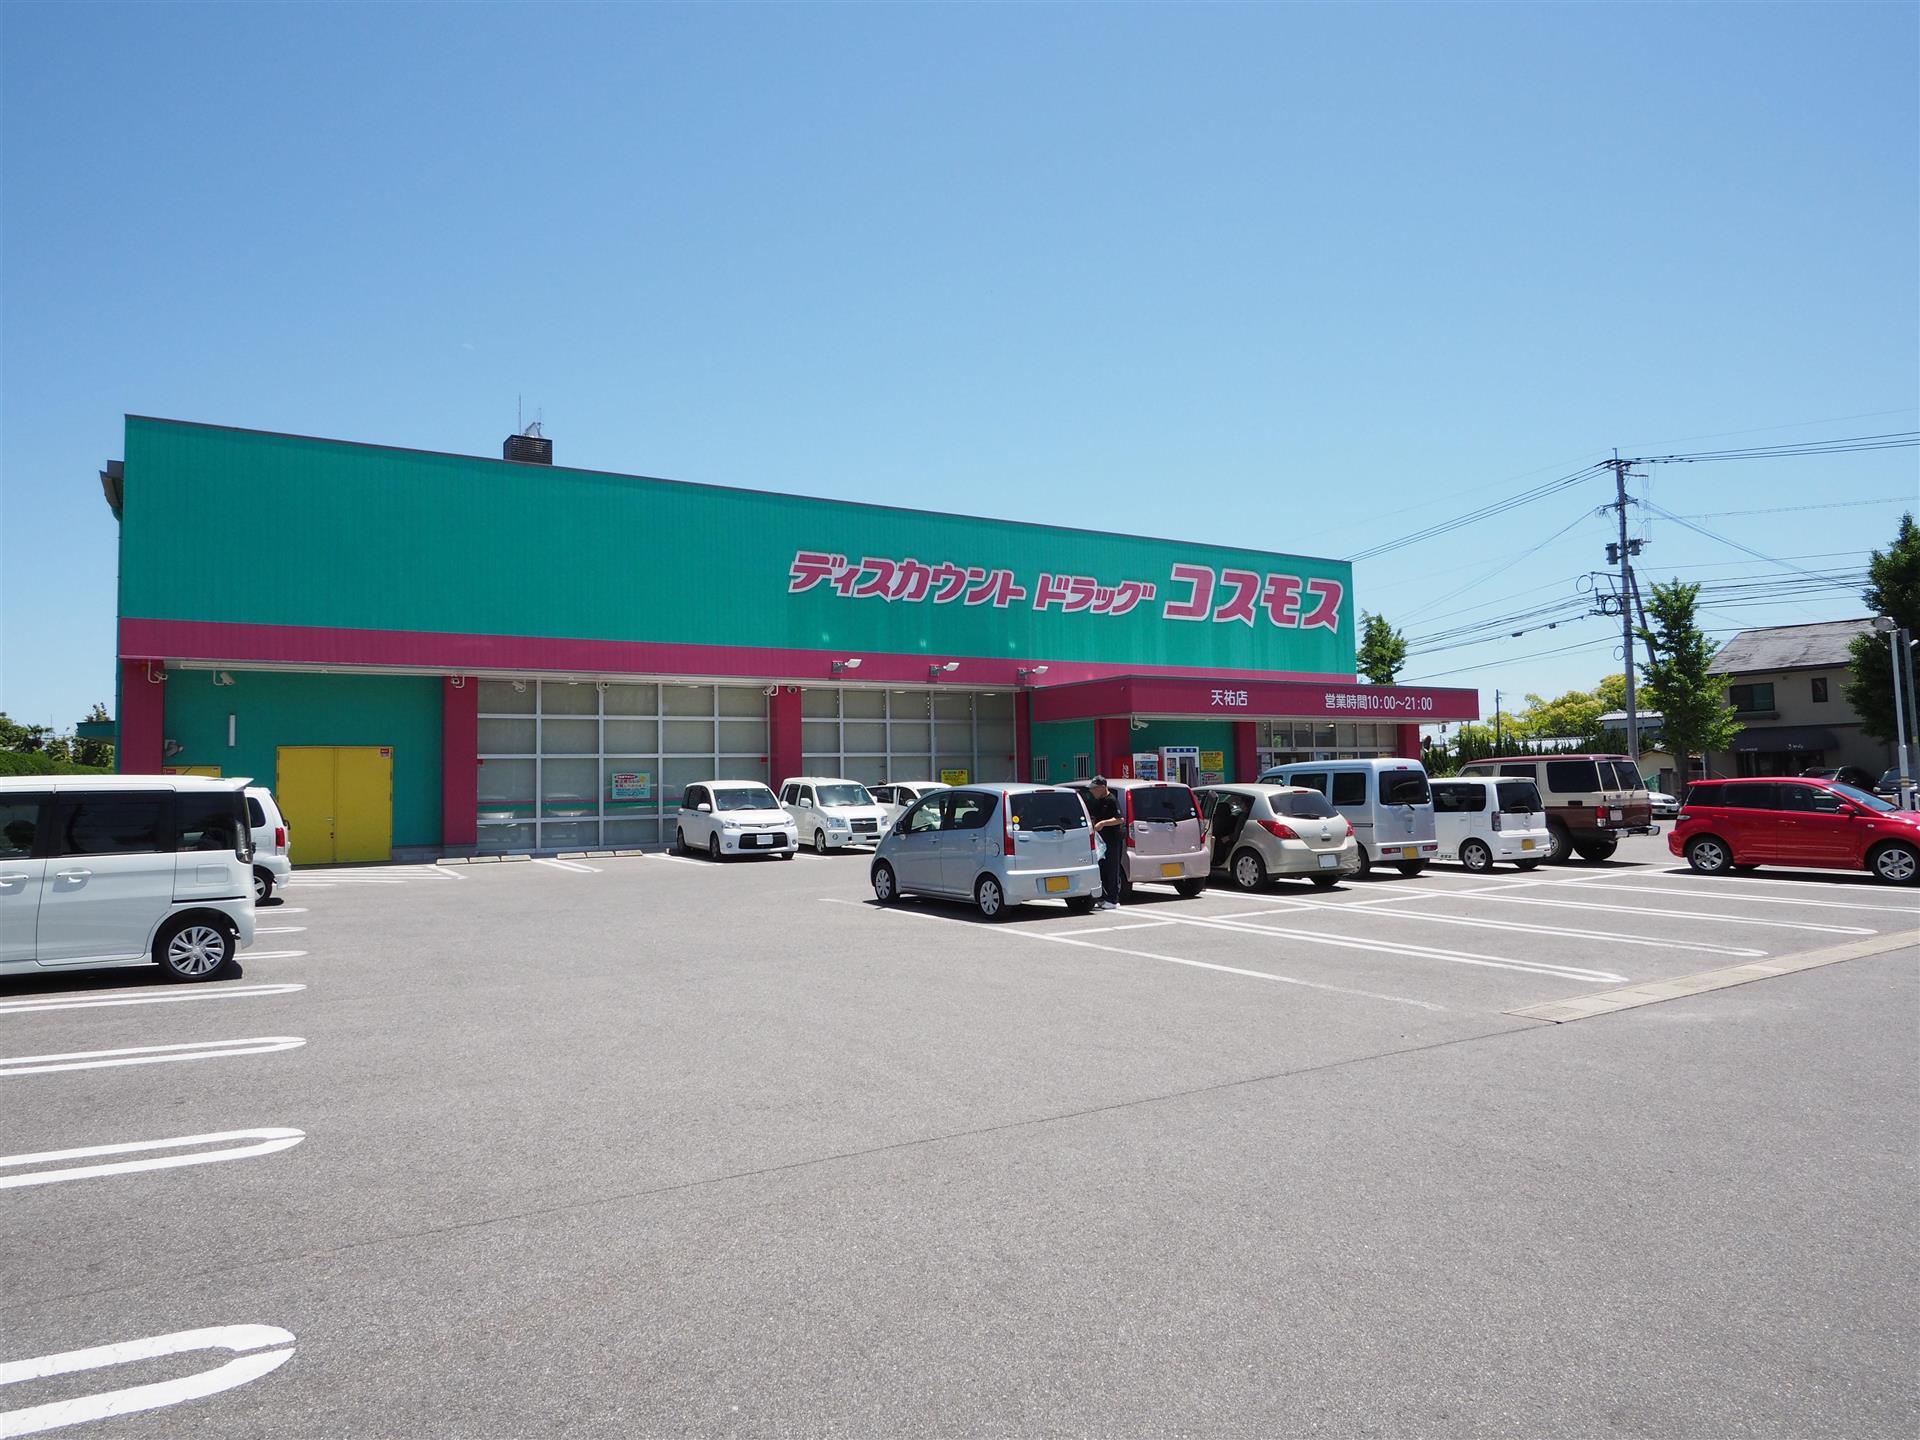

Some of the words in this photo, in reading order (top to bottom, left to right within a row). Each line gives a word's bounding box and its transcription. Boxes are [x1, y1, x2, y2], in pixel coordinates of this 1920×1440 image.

[789, 551, 1025, 608] ディスカウント
[1033, 573, 1156, 614] ドラッグ
[1163, 563, 1344, 633] コスモス
[1211, 689, 1248, 706] 天祐店
